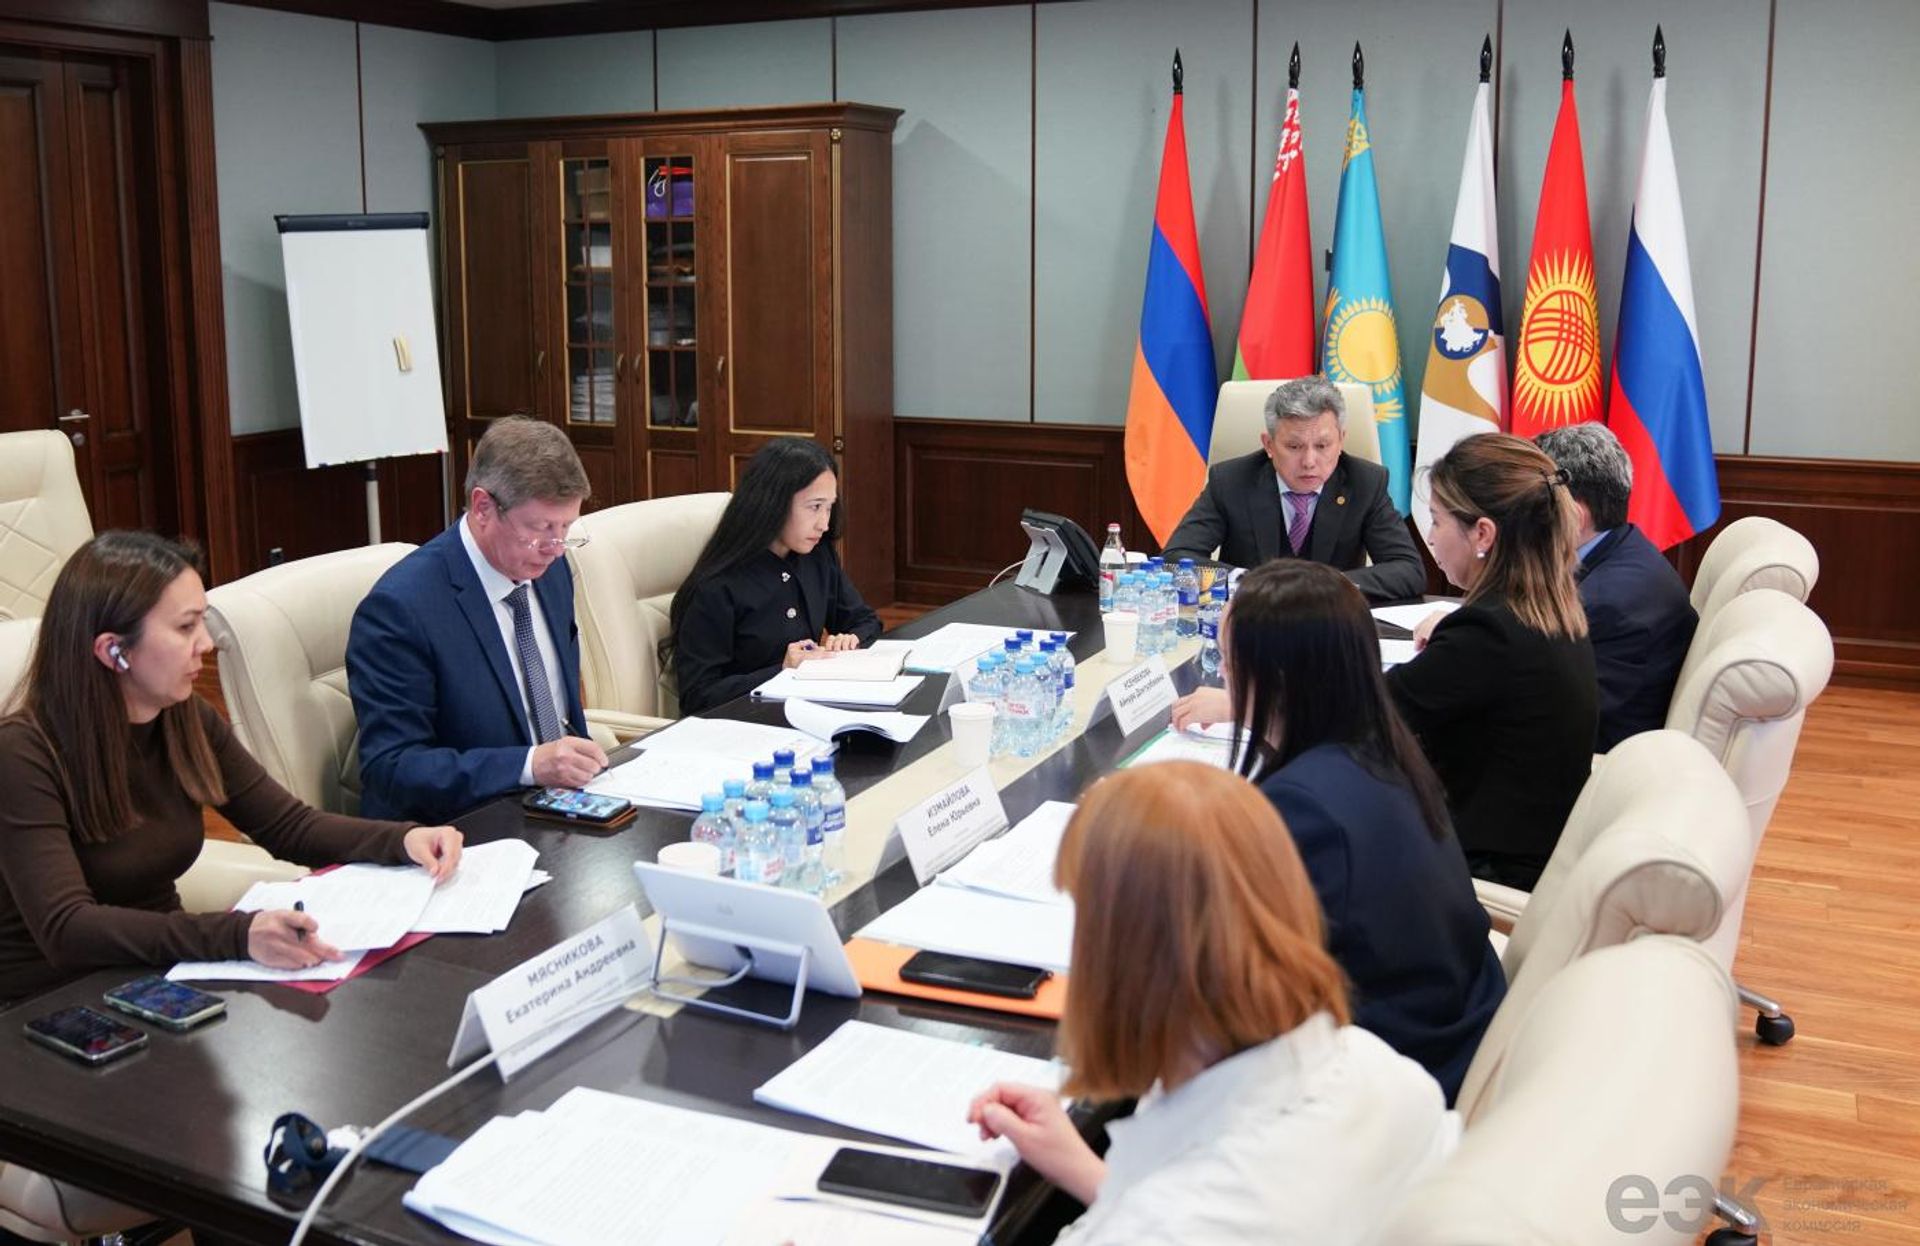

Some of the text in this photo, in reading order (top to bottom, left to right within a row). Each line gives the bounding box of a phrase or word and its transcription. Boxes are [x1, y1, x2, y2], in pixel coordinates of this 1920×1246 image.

[927, 784, 970, 818] ИЗМАЙЛОВА
[927, 819, 950, 837] Елена
[950, 797, 981, 823] Юрьевна
[505, 979, 573, 1025] Екатерина
[575, 938, 637, 983] Андреевна
[527, 934, 604, 987] МЯСНИКОВА
